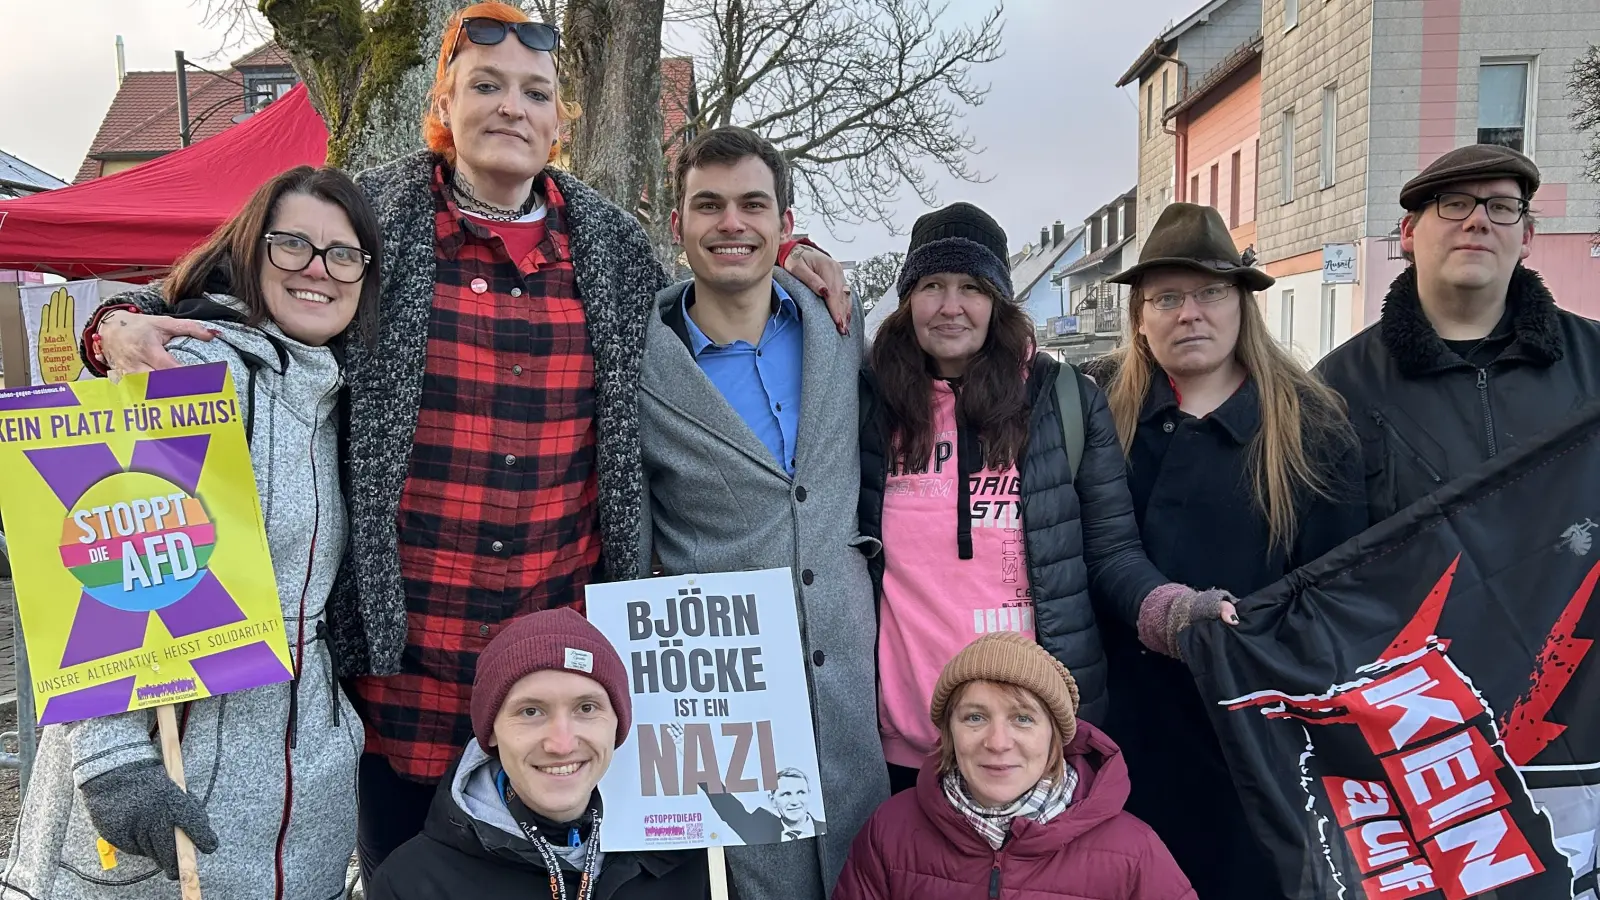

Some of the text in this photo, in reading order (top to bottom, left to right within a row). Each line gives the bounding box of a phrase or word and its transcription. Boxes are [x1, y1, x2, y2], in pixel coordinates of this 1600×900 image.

[42, 344, 73, 353] meinen
[43, 354, 75, 363] Kumpel
[44, 334, 67, 343] Mach'
[49, 364, 71, 372] nicht
[54, 373, 68, 381] an!
[51, 410, 115, 438] PLATZ
[123, 403, 163, 432] FÜR
[170, 399, 237, 428] NAZIS!
[73, 493, 187, 544] STOPPT
[88, 532, 198, 592] DIE AFD
[627, 588, 760, 641] BJÖRN
[37, 672, 81, 694] UNSERE
[87, 652, 159, 681] ALTERNATIVE
[164, 639, 201, 659] HEISST
[631, 639, 767, 694] HÖCKE
[674, 698, 729, 717] IST EIN
[636, 720, 779, 797] NAZI
[1362, 665, 1535, 896] KEIN
[644, 812, 702, 823] #STOPPTDIEAFD
[1342, 778, 1434, 893] auf
